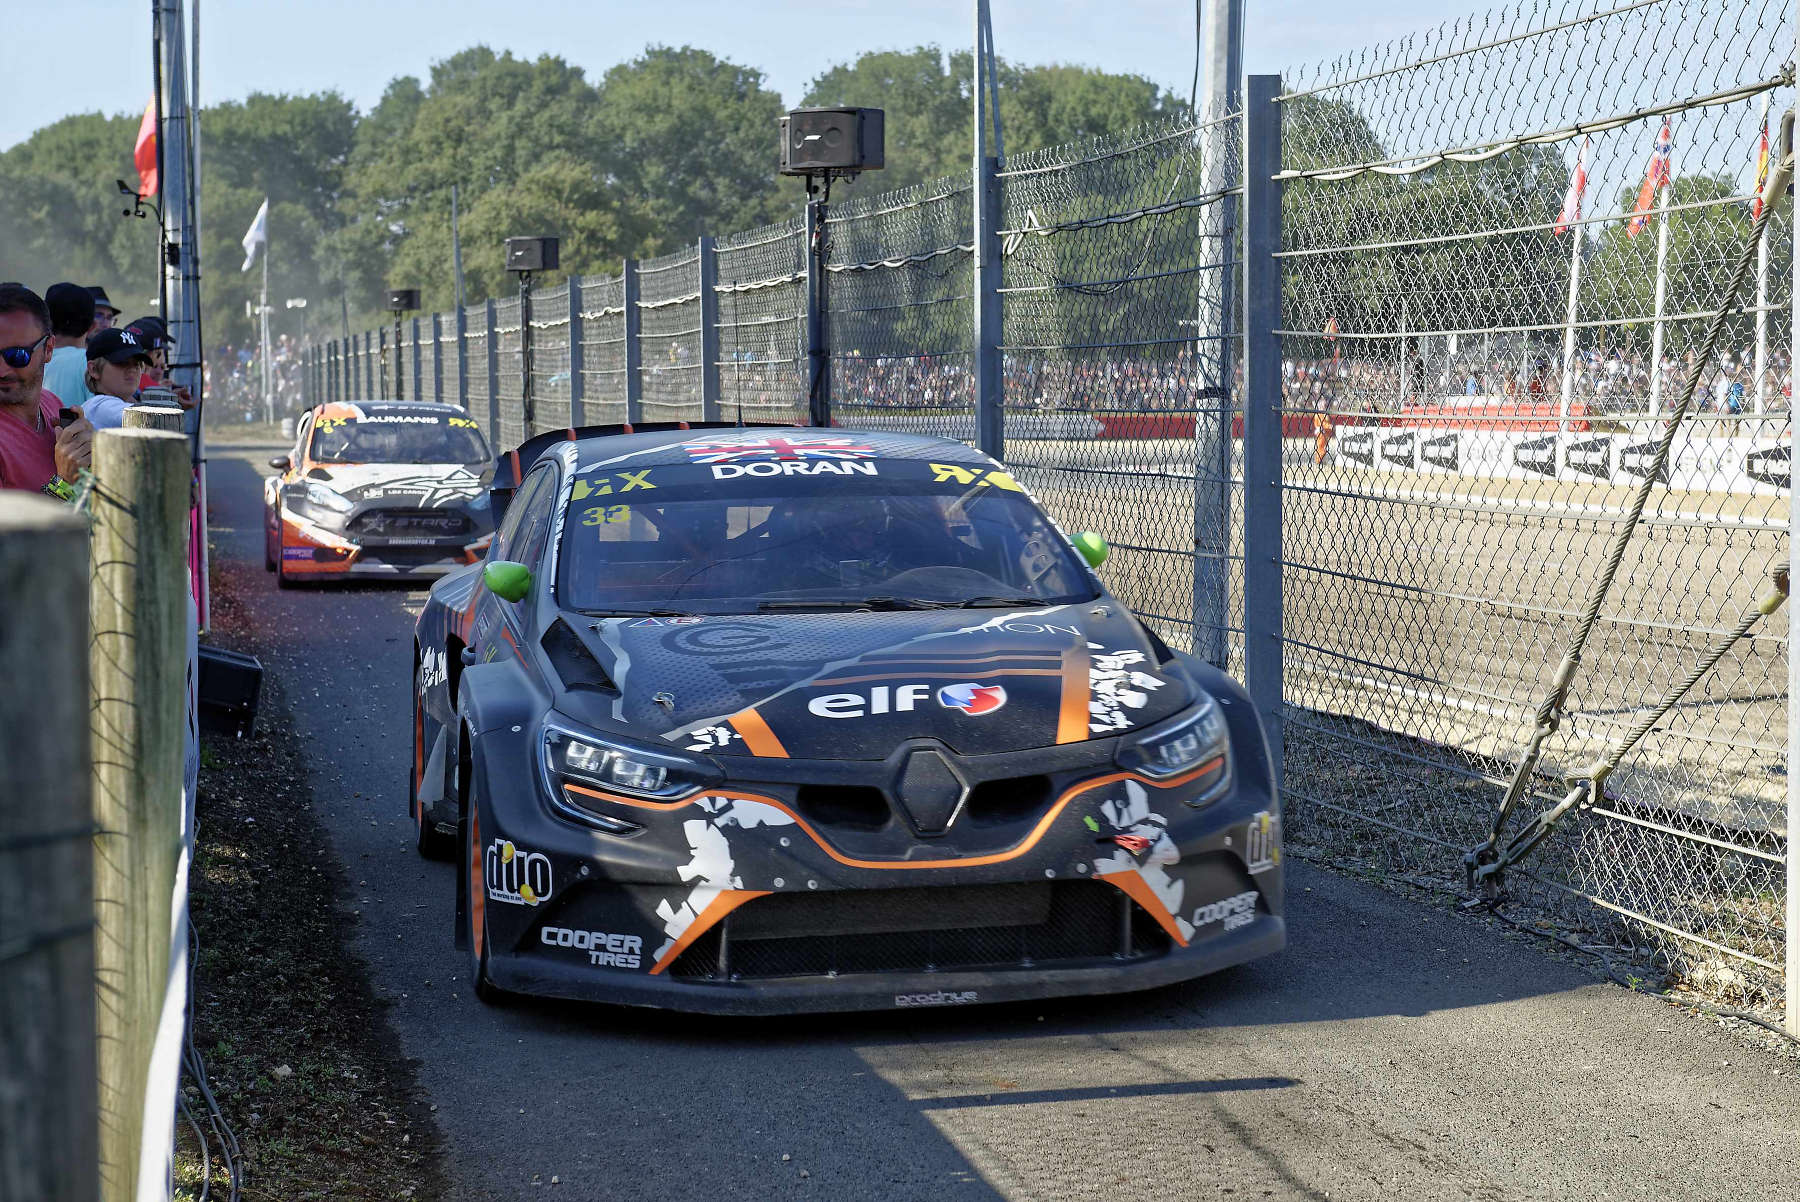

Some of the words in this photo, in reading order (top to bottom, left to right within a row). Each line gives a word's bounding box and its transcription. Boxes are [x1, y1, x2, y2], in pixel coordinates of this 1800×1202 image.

[120, 332, 136, 344] NY
[711, 461, 878, 480] DORAN
[582, 504, 631, 526] 33
[807, 684, 930, 719] elf
[541, 926, 643, 954] COOPER
[589, 950, 641, 969] TIRES
